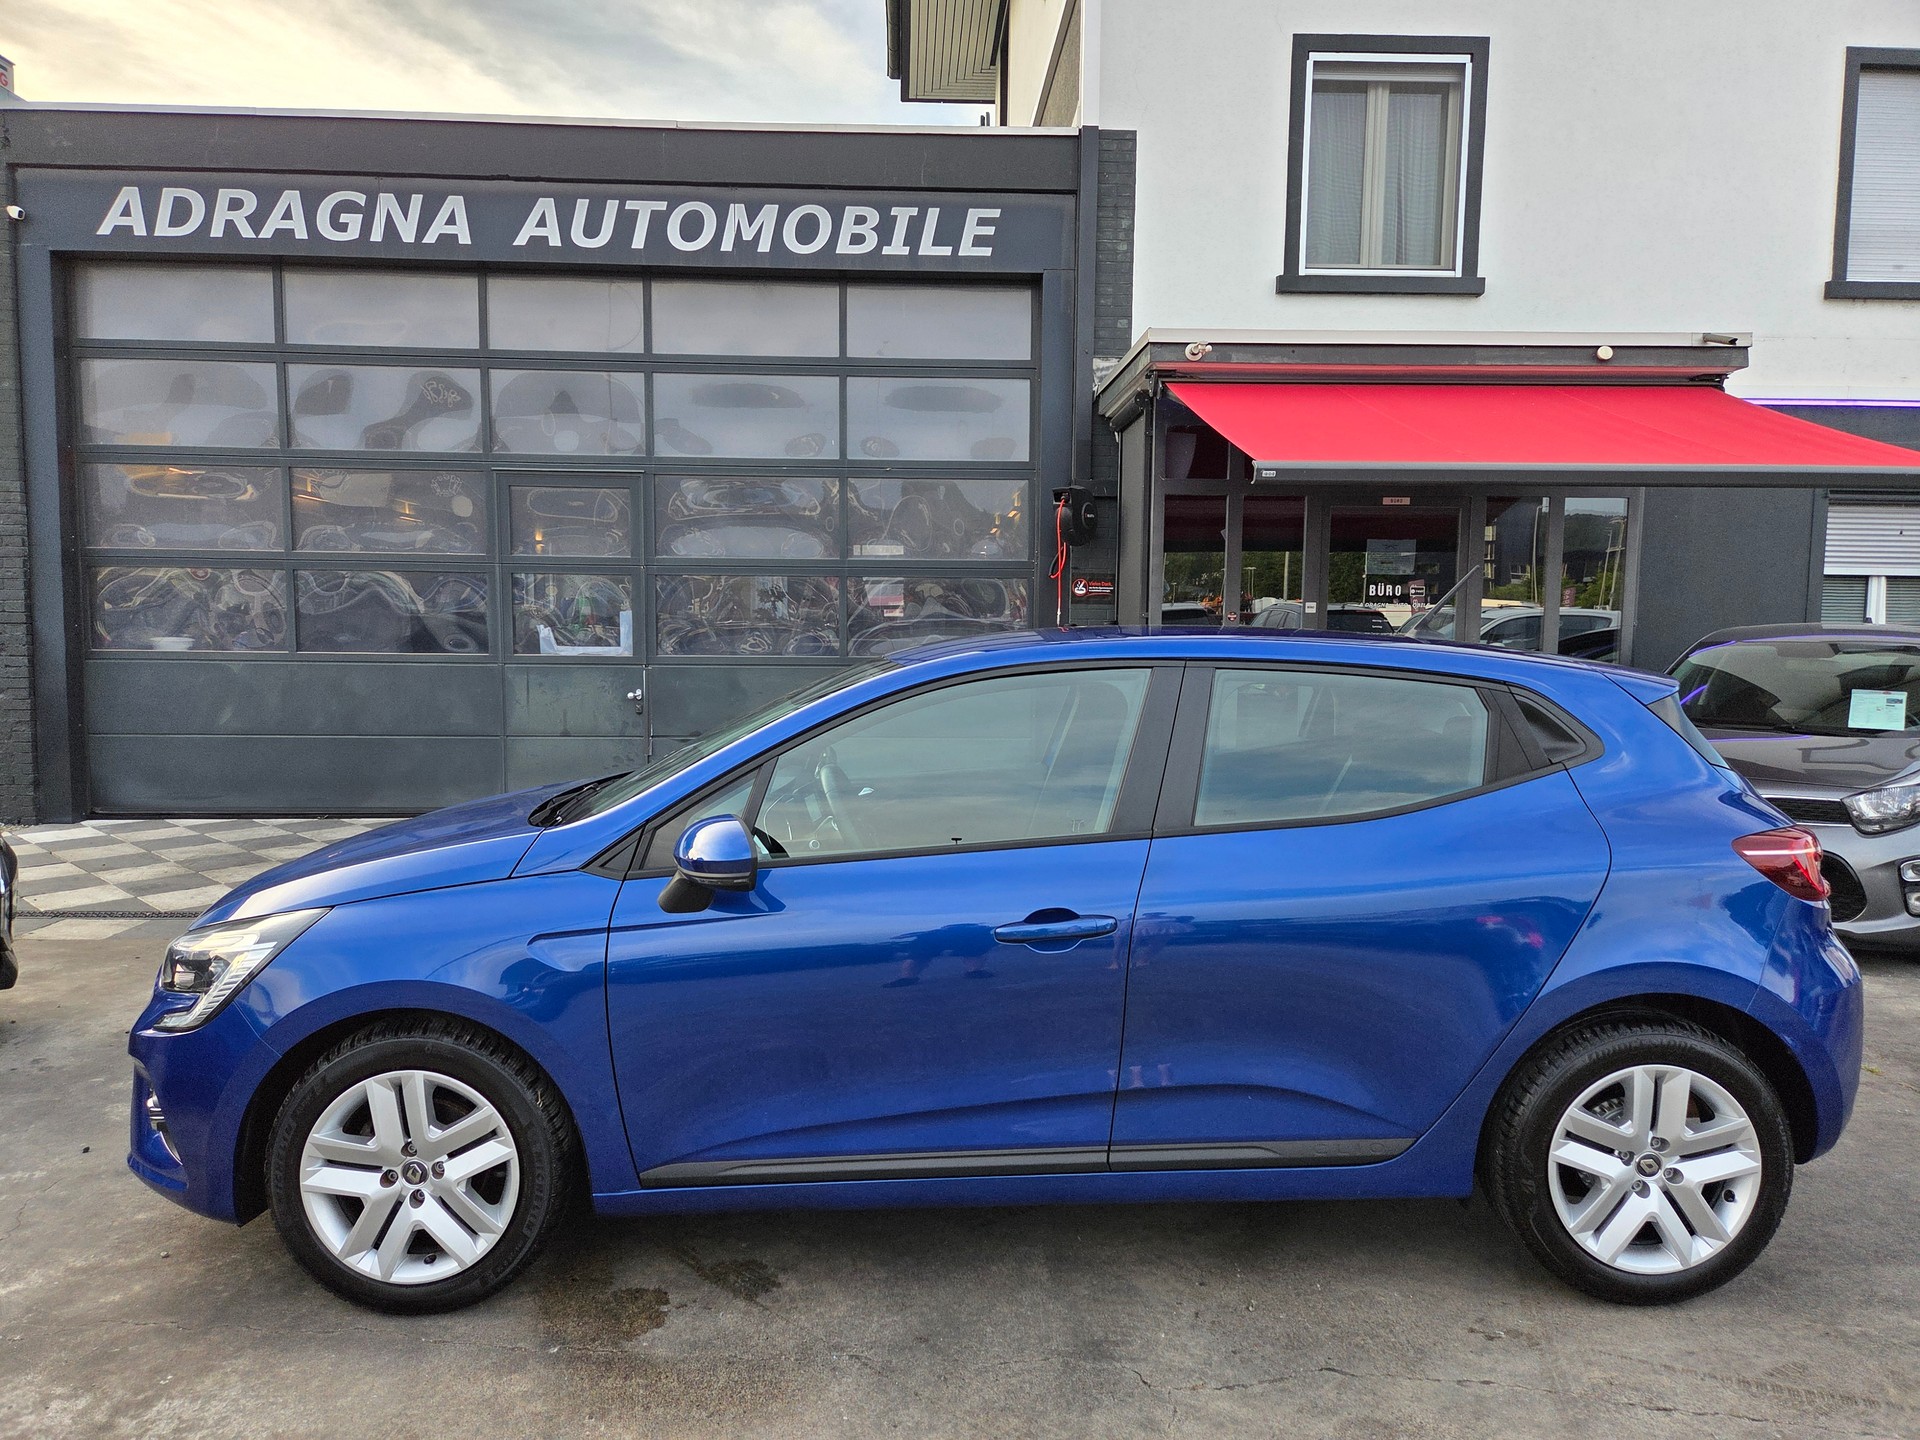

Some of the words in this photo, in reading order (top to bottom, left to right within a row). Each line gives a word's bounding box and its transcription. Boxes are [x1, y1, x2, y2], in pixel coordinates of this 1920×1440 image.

[96, 186, 472, 245] ADRAGNA
[513, 197, 1002, 257] AUTOMOBILE
[1369, 582, 1402, 596] BÜRO
